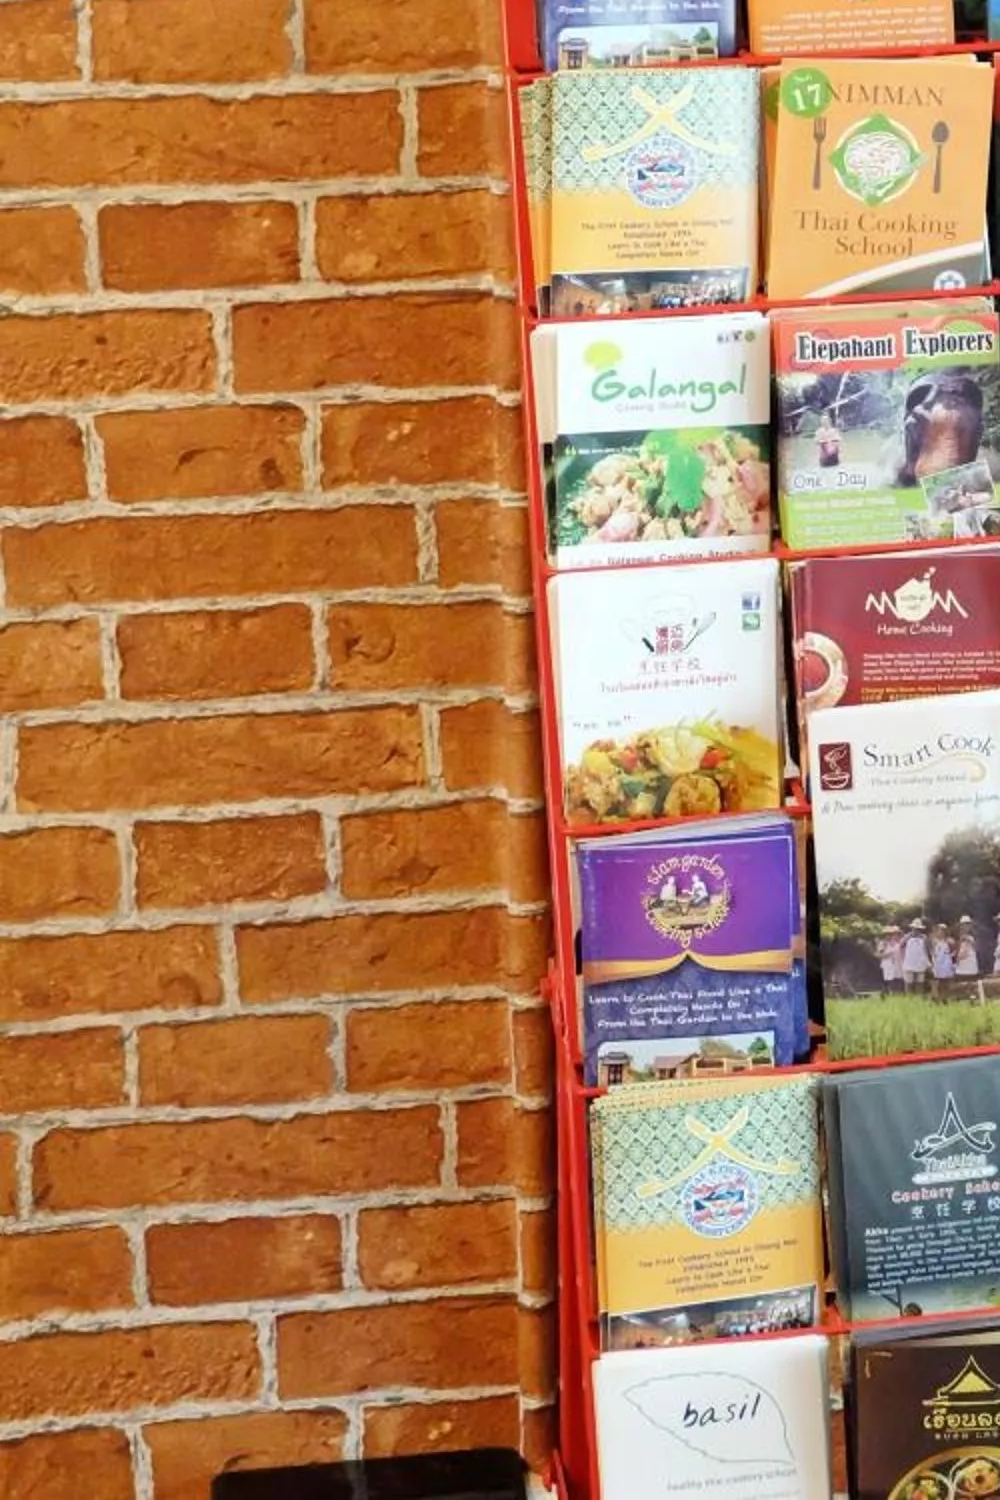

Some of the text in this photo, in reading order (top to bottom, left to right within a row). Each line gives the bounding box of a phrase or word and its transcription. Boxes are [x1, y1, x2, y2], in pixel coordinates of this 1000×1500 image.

[793, 83, 821, 112] 17
[827, 82, 945, 106] NIMMAN
[796, 211, 957, 240] Thai Cooking
[835, 236, 914, 257] School
[798, 329, 993, 361] Elepahant Explorers
[591, 364, 746, 412] Galangal
[794, 472, 867, 489] One Day
[863, 732, 994, 768] Smart Cook
[683, 1392, 761, 1428] basil
